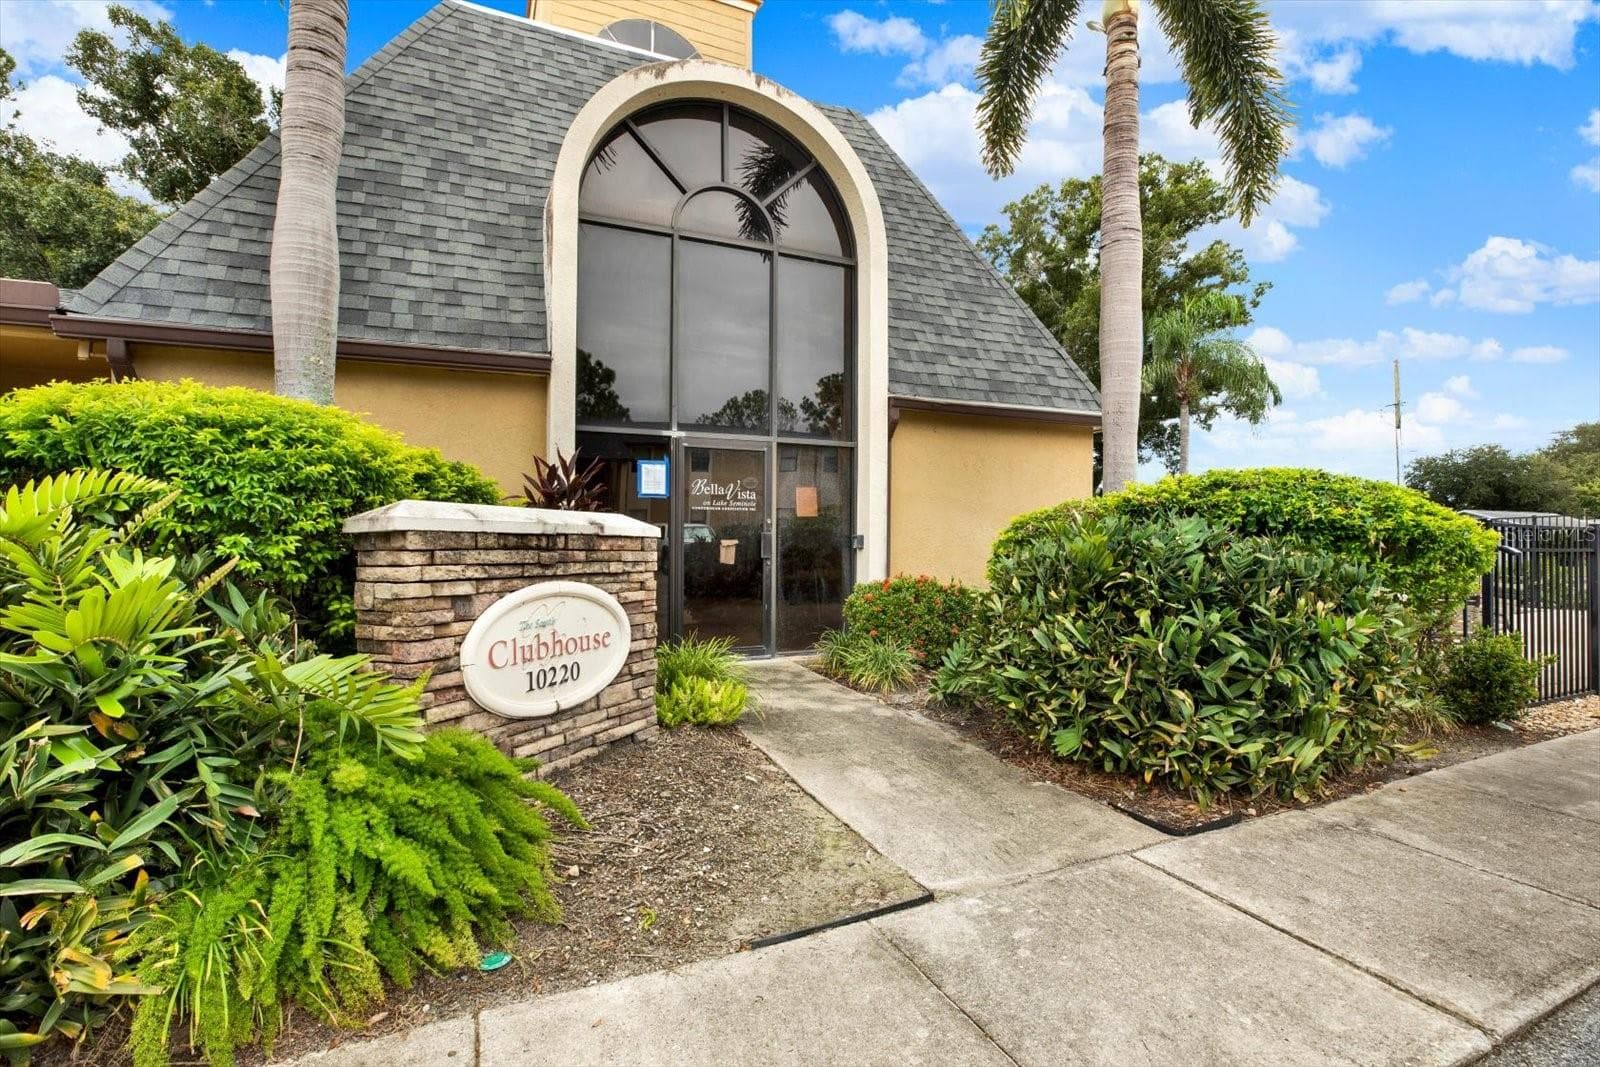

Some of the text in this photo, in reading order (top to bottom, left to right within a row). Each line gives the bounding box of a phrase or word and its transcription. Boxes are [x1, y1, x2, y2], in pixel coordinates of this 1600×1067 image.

[691, 479, 756, 500] Bella Vista
[487, 628, 612, 670] Clubhouse
[525, 661, 581, 693] 10220
